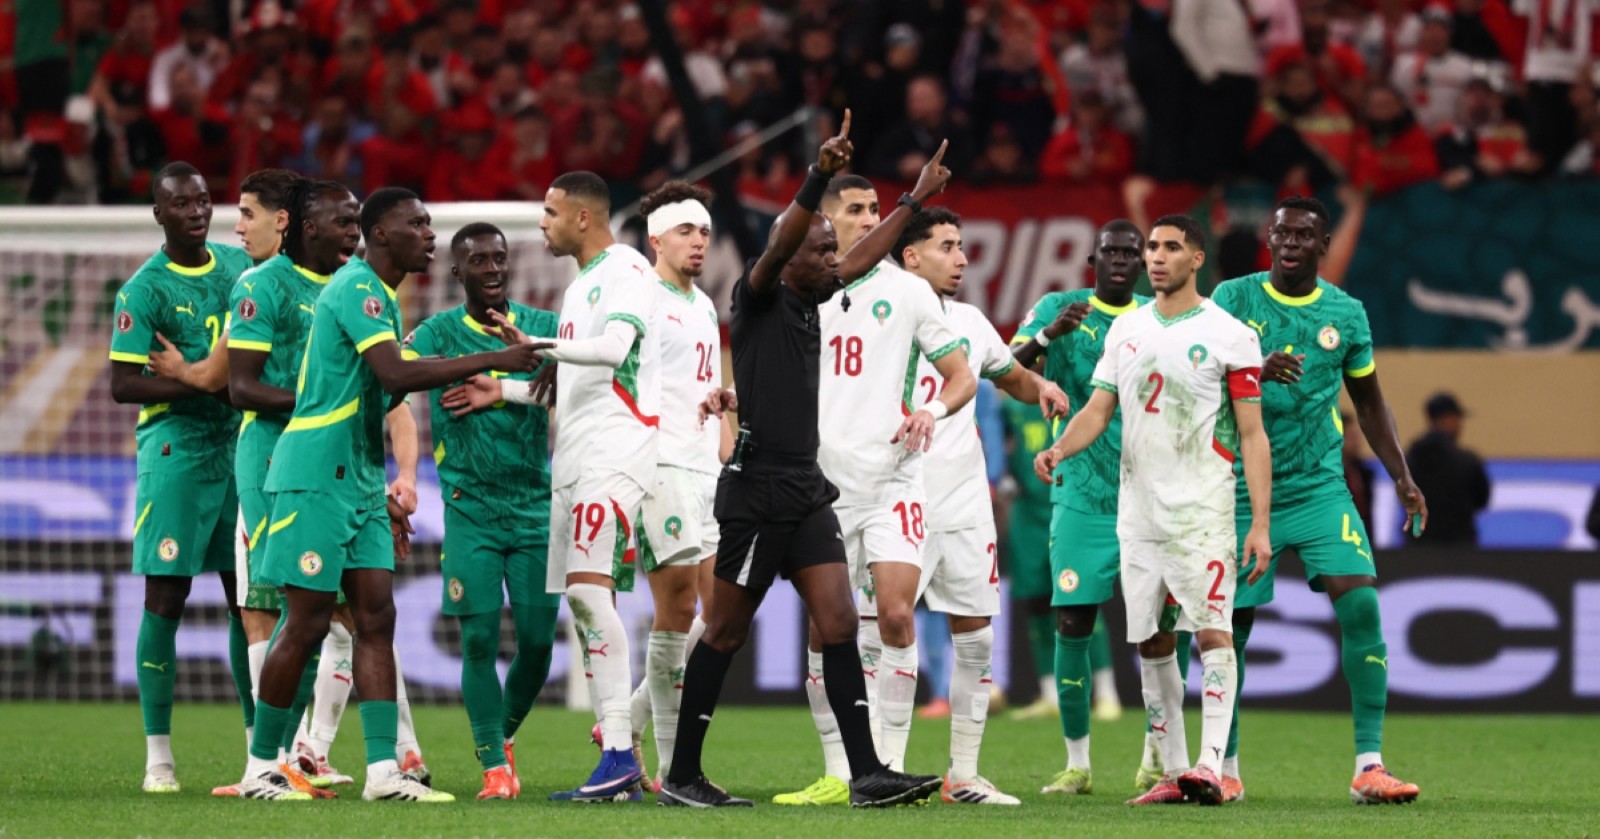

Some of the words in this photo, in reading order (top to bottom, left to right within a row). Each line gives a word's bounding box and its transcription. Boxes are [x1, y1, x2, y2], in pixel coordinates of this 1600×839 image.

[205, 310, 232, 354] 2
[695, 340, 713, 383] 24
[828, 335, 863, 377] 18
[920, 375, 950, 404] 2
[1144, 372, 1164, 413] 2
[572, 502, 606, 542] 19
[892, 500, 925, 540] 18
[1341, 513, 1362, 547] 4
[1206, 560, 1226, 601] 2
